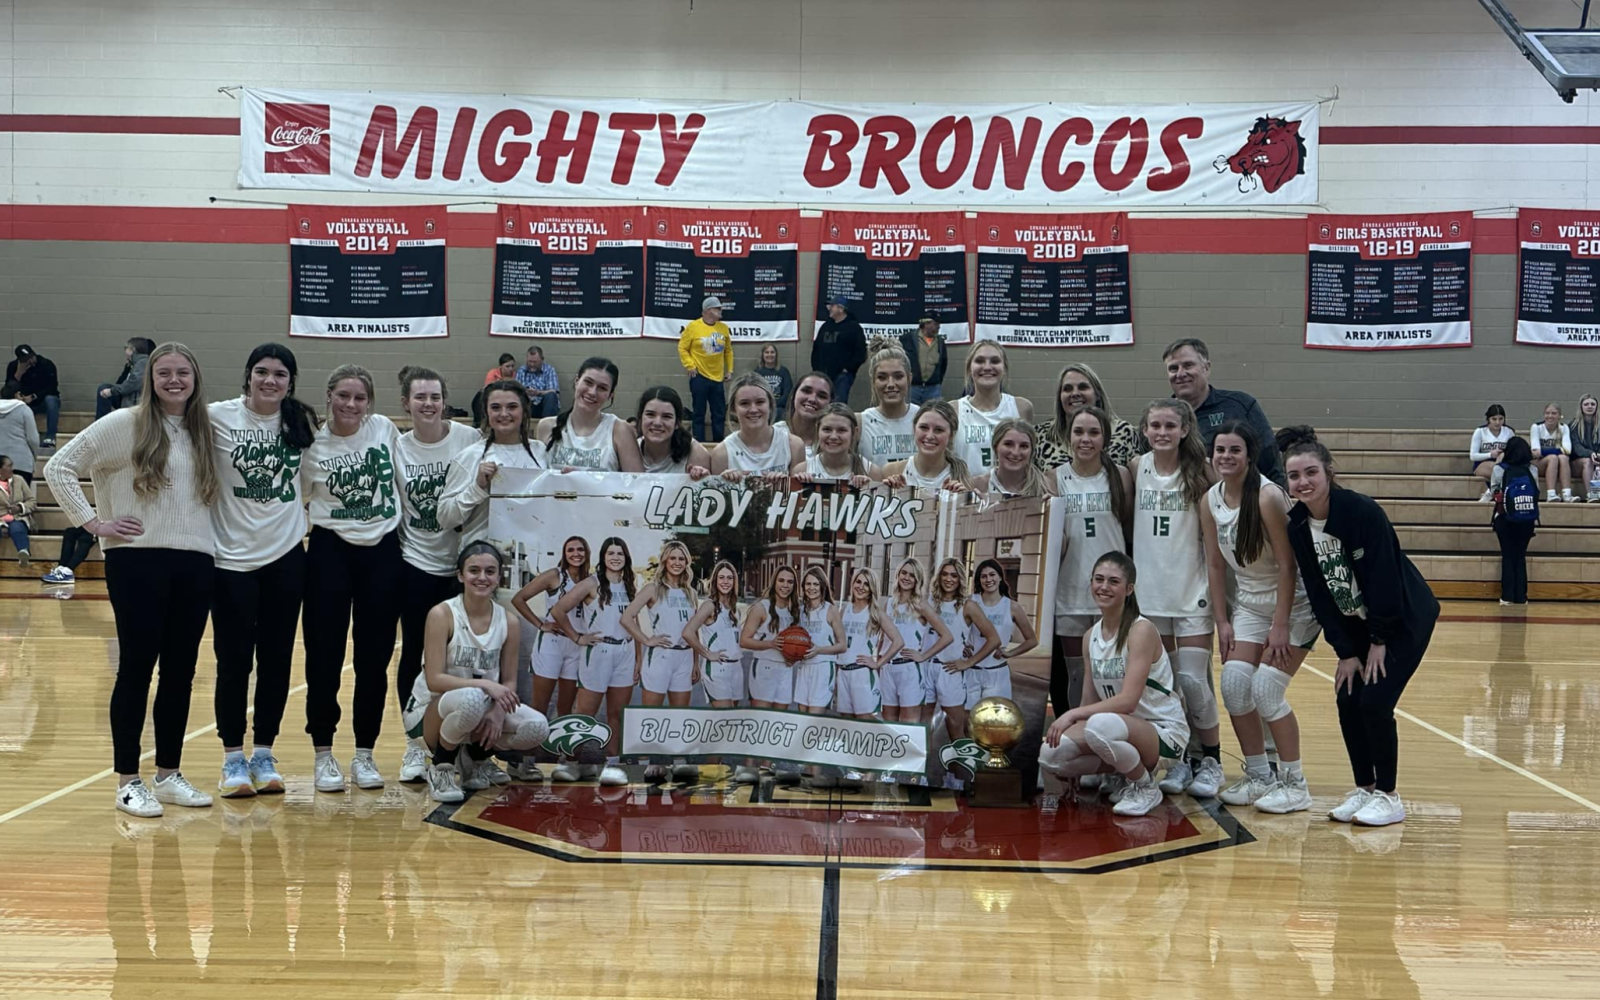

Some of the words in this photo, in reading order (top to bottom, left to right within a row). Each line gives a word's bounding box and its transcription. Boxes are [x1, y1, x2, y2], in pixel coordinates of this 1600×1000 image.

[353, 105, 706, 186] MIGHTY
[802, 114, 1204, 196] BRONCOS
[326, 222, 409, 235] VOLLEYBALL
[529, 222, 607, 235] VOLLEYBALL
[682, 225, 762, 238] VOLLEYBALL
[854, 229, 931, 241] VOLLEYBALL
[1014, 230, 1096, 242] VOLLEYBALL
[1336, 227, 1367, 240] GIRLS
[1370, 225, 1443, 239] BASKETBALL
[1558, 225, 1600, 238] VOLLE
[346, 236, 389, 251] 2014
[547, 236, 588, 251] 2015
[700, 239, 743, 254] 2016
[871, 242, 914, 257] 2017
[1033, 243, 1076, 258] 2018
[1363, 240, 1414, 256] '18-19
[1577, 240, 1600, 255] 20
[328, 324, 354, 333] AREA
[357, 324, 410, 333] FINALISTS
[513, 326, 548, 334] REGIONAL
[549, 327, 584, 335] QUARTER
[585, 327, 624, 335] FINALISTS
[524, 320, 568, 328] CO-DISTRICT
[1557, 327, 1592, 335] DISTRICT
[1071, 335, 1110, 343] FINALISTS
[1345, 331, 1373, 340] AREA
[1376, 329, 1432, 340] FINALISTS
[1567, 334, 1589, 342] AREA
[230, 429, 276, 443] WALL
[319, 451, 366, 472] WALL
[405, 462, 446, 478] WALL
[644, 485, 753, 528] LADY
[766, 490, 923, 540] HAWKS
[1084, 517, 1096, 538] 5
[1153, 516, 1170, 536] 15
[640, 717, 798, 748] BI-DISTRICT
[802, 726, 910, 758] CHAMPS
